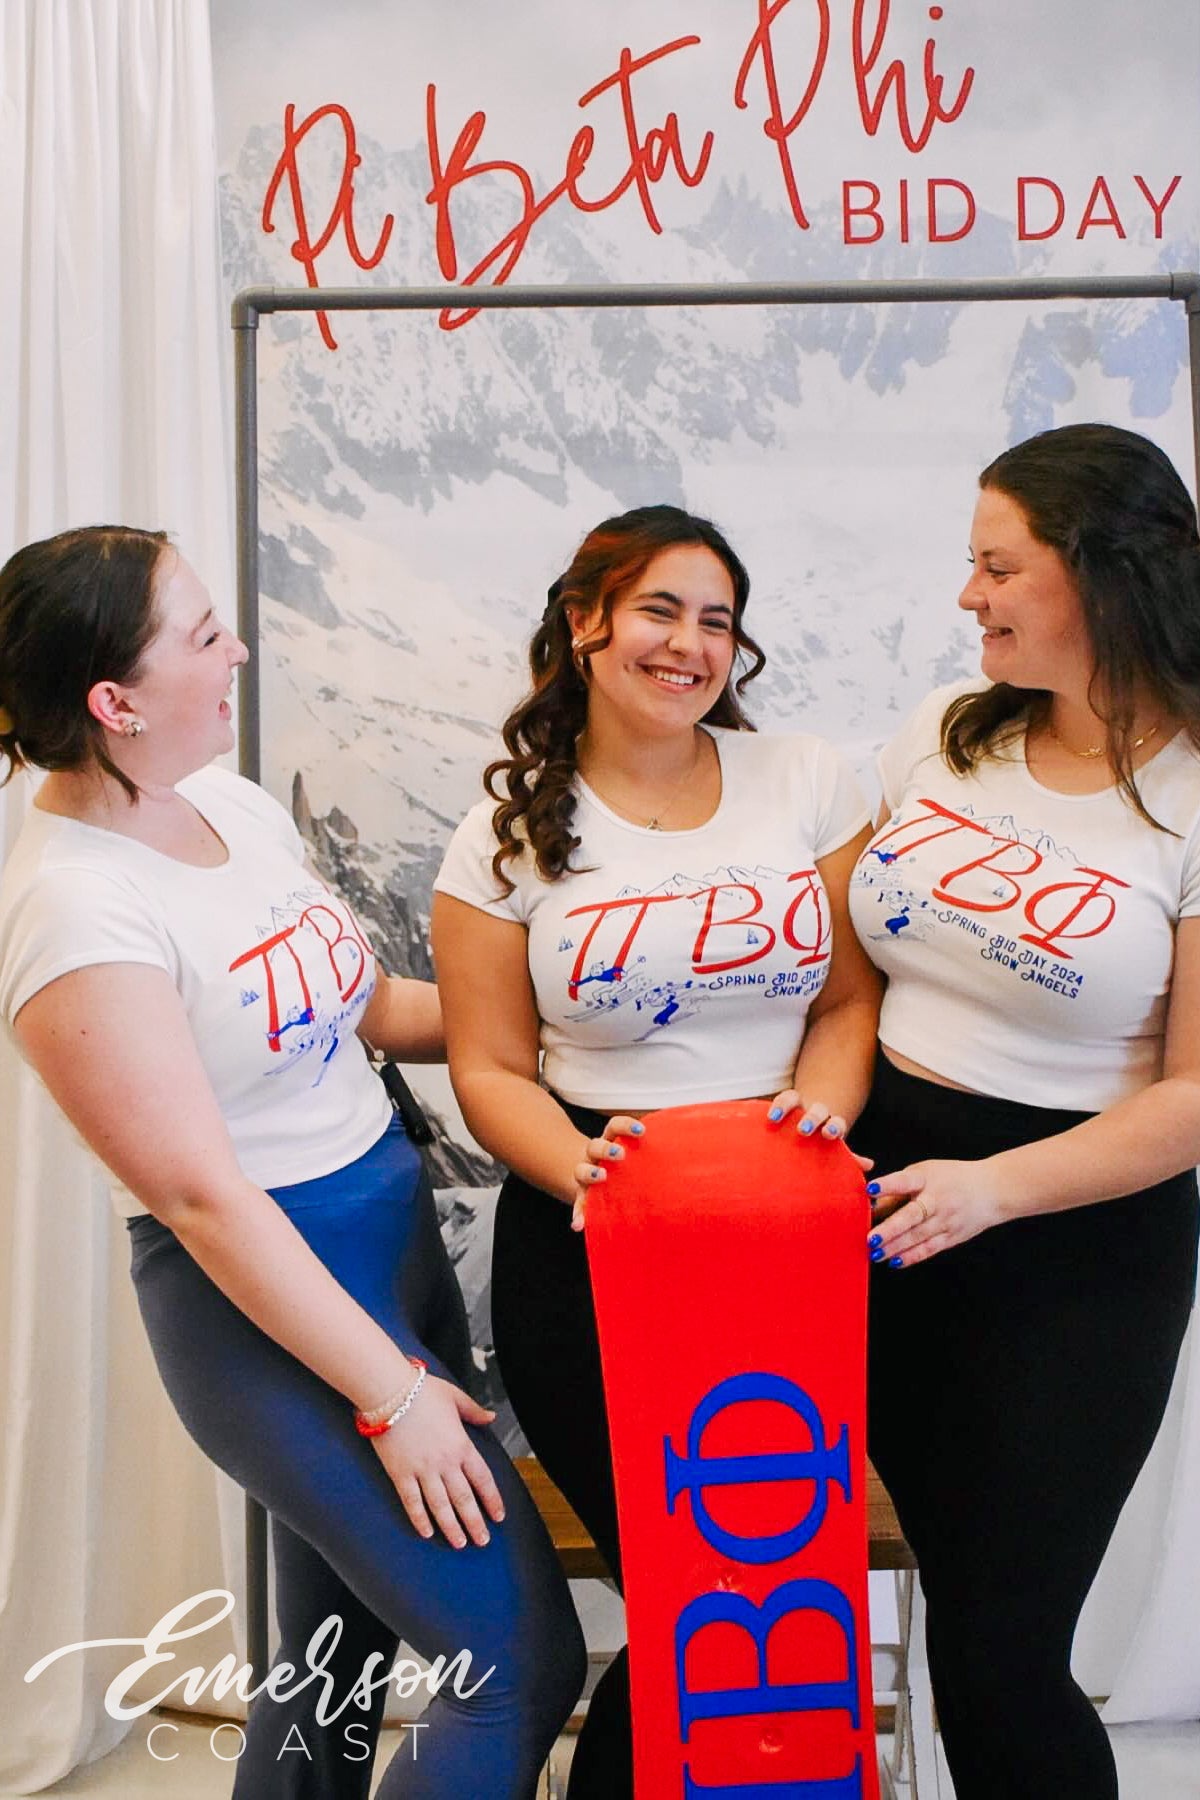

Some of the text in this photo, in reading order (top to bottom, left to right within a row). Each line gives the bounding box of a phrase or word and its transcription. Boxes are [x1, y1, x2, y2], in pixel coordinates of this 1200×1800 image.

[263, 0, 975, 350] Pi Beta Phi
[842, 174, 1182, 245] BID DAY
[709, 973, 767, 991] SPRING
[938, 910, 1084, 987] SPRING BID DAY 2024
[980, 946, 1079, 999] SNOW ANGELS
[664, 1371, 863, 1800] ΒΦ
